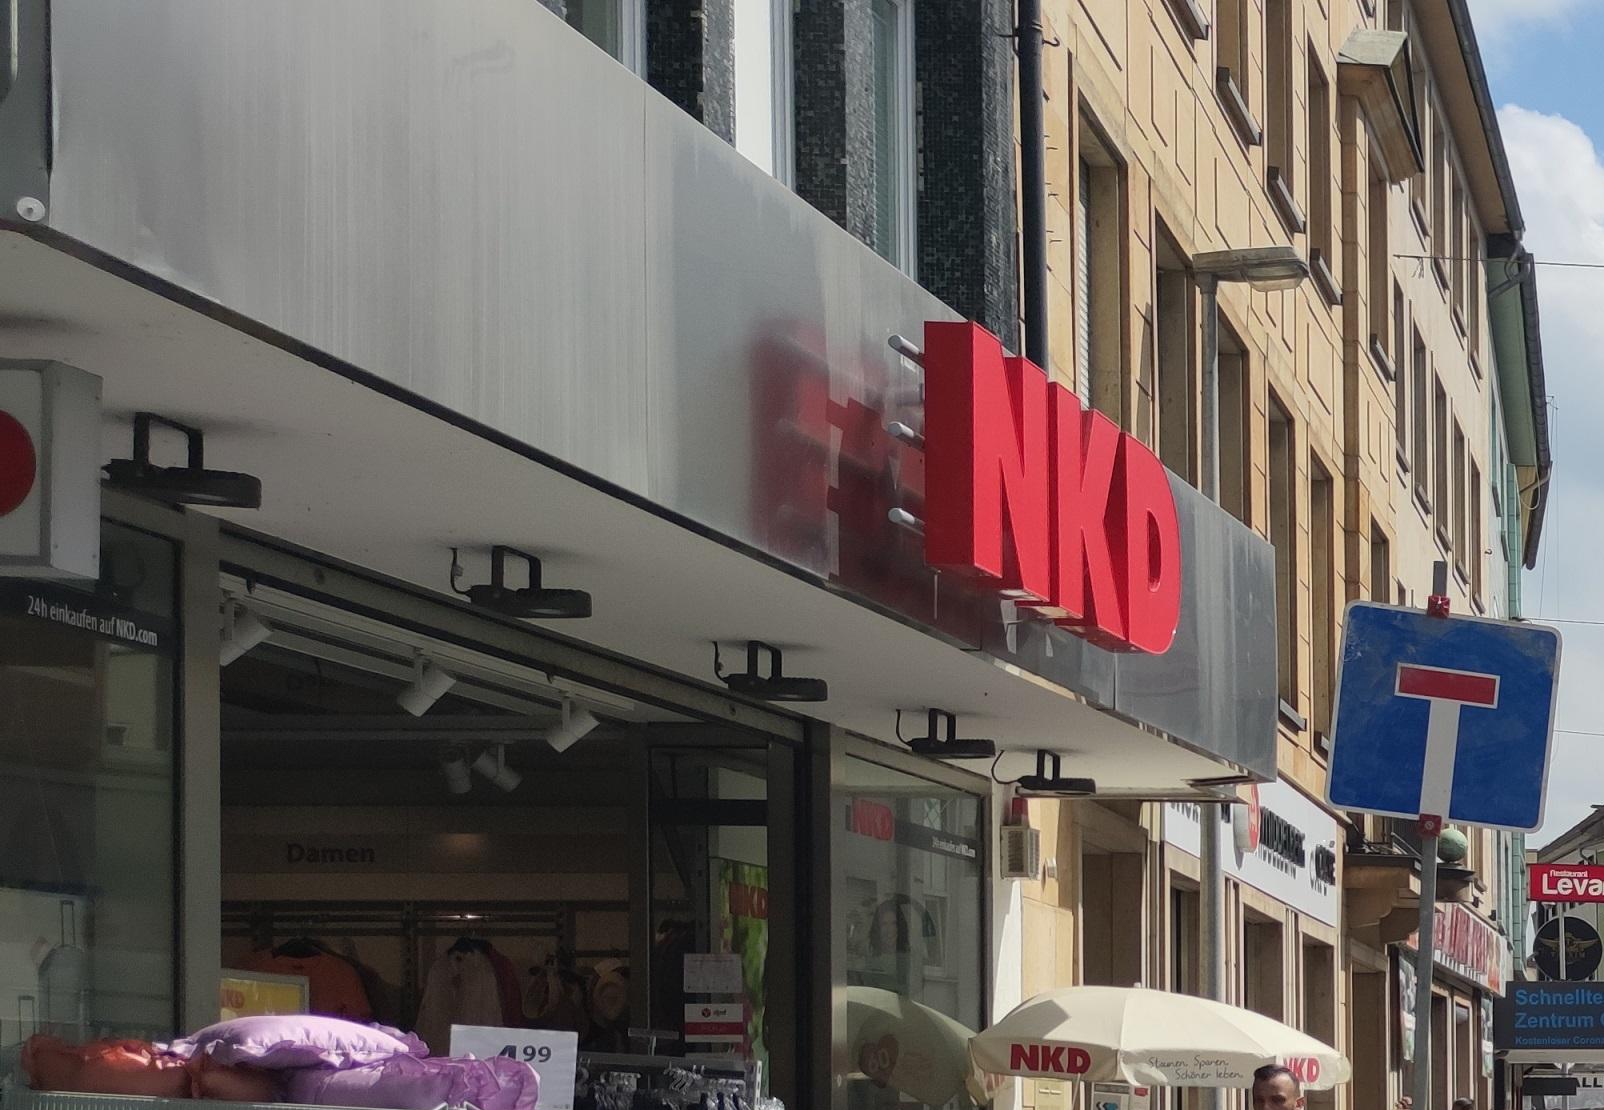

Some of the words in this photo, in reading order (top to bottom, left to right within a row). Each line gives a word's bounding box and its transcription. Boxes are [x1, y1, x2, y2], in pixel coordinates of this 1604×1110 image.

[924, 321, 1181, 654] NKD
[28, 595, 47, 618] 24h
[50, 603, 98, 632] einkaufen
[99, 617, 115, 634] auf
[116, 619, 158, 647] NKD.com
[286, 842, 375, 864] Damen
[1514, 1012, 1594, 1029] Zentrum
[1515, 1035, 1571, 1046] Kostenloser
[1010, 1043, 1091, 1075] NKD
[1175, 1068, 1211, 1080] Schöner
